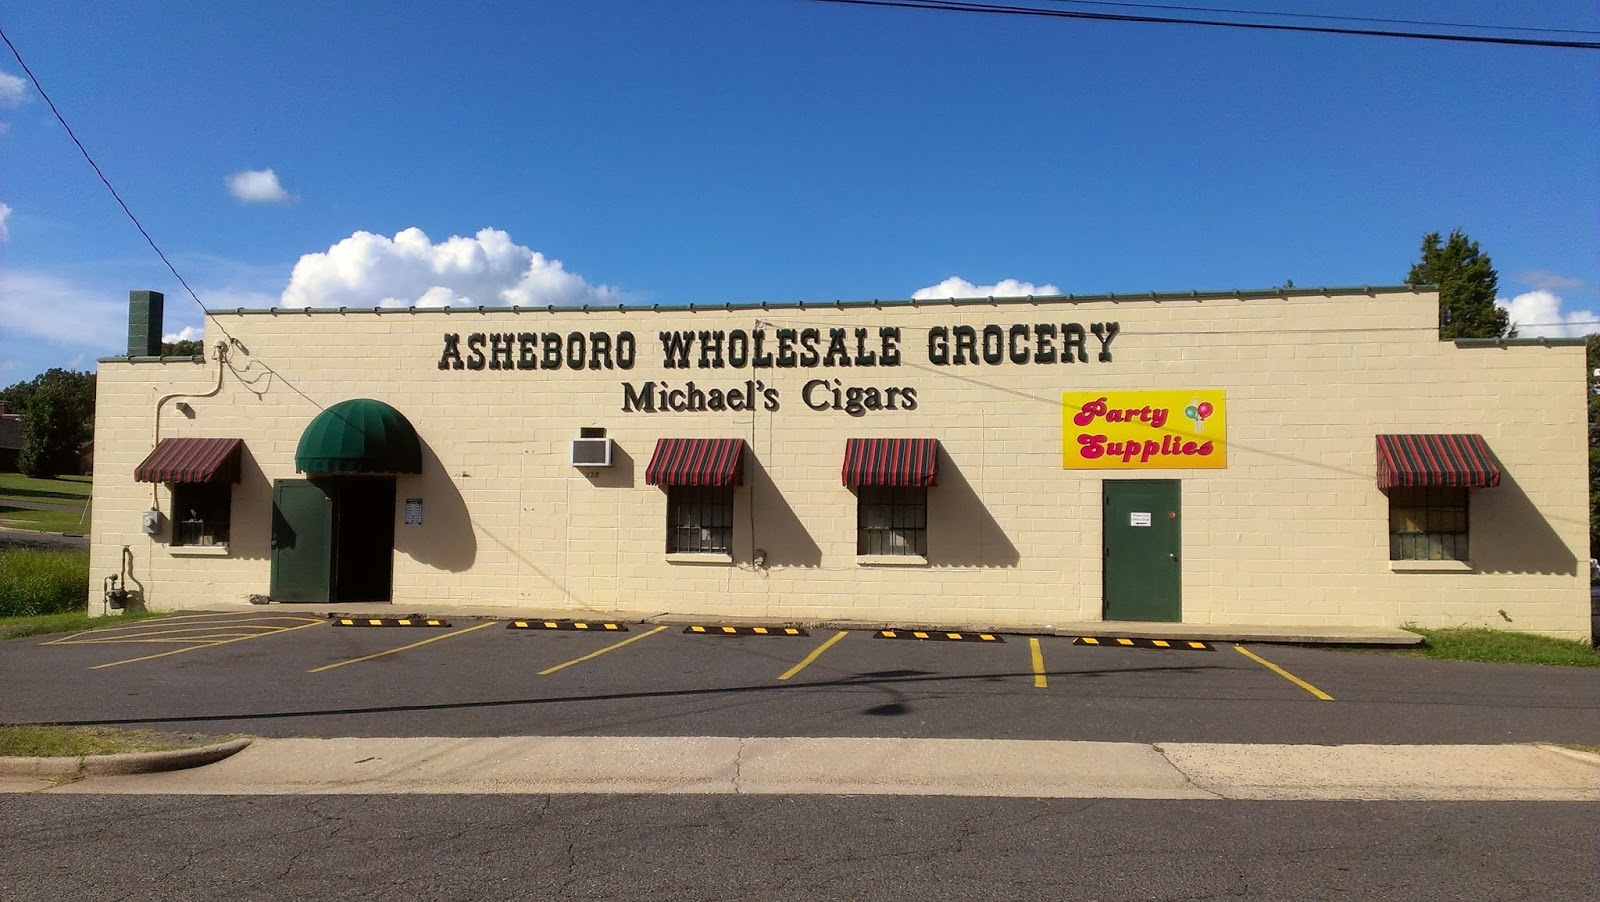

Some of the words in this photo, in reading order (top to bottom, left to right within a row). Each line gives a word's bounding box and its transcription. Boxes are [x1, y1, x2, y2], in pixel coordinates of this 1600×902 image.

[438, 331, 636, 370] ASHEBORO
[659, 327, 902, 368] WHOLESALE
[927, 322, 1120, 365] GROCERY
[620, 379, 780, 413] Michael's
[802, 378, 918, 418] Cigars
[1073, 396, 1170, 429] Party
[1077, 433, 1214, 463] Supplies
